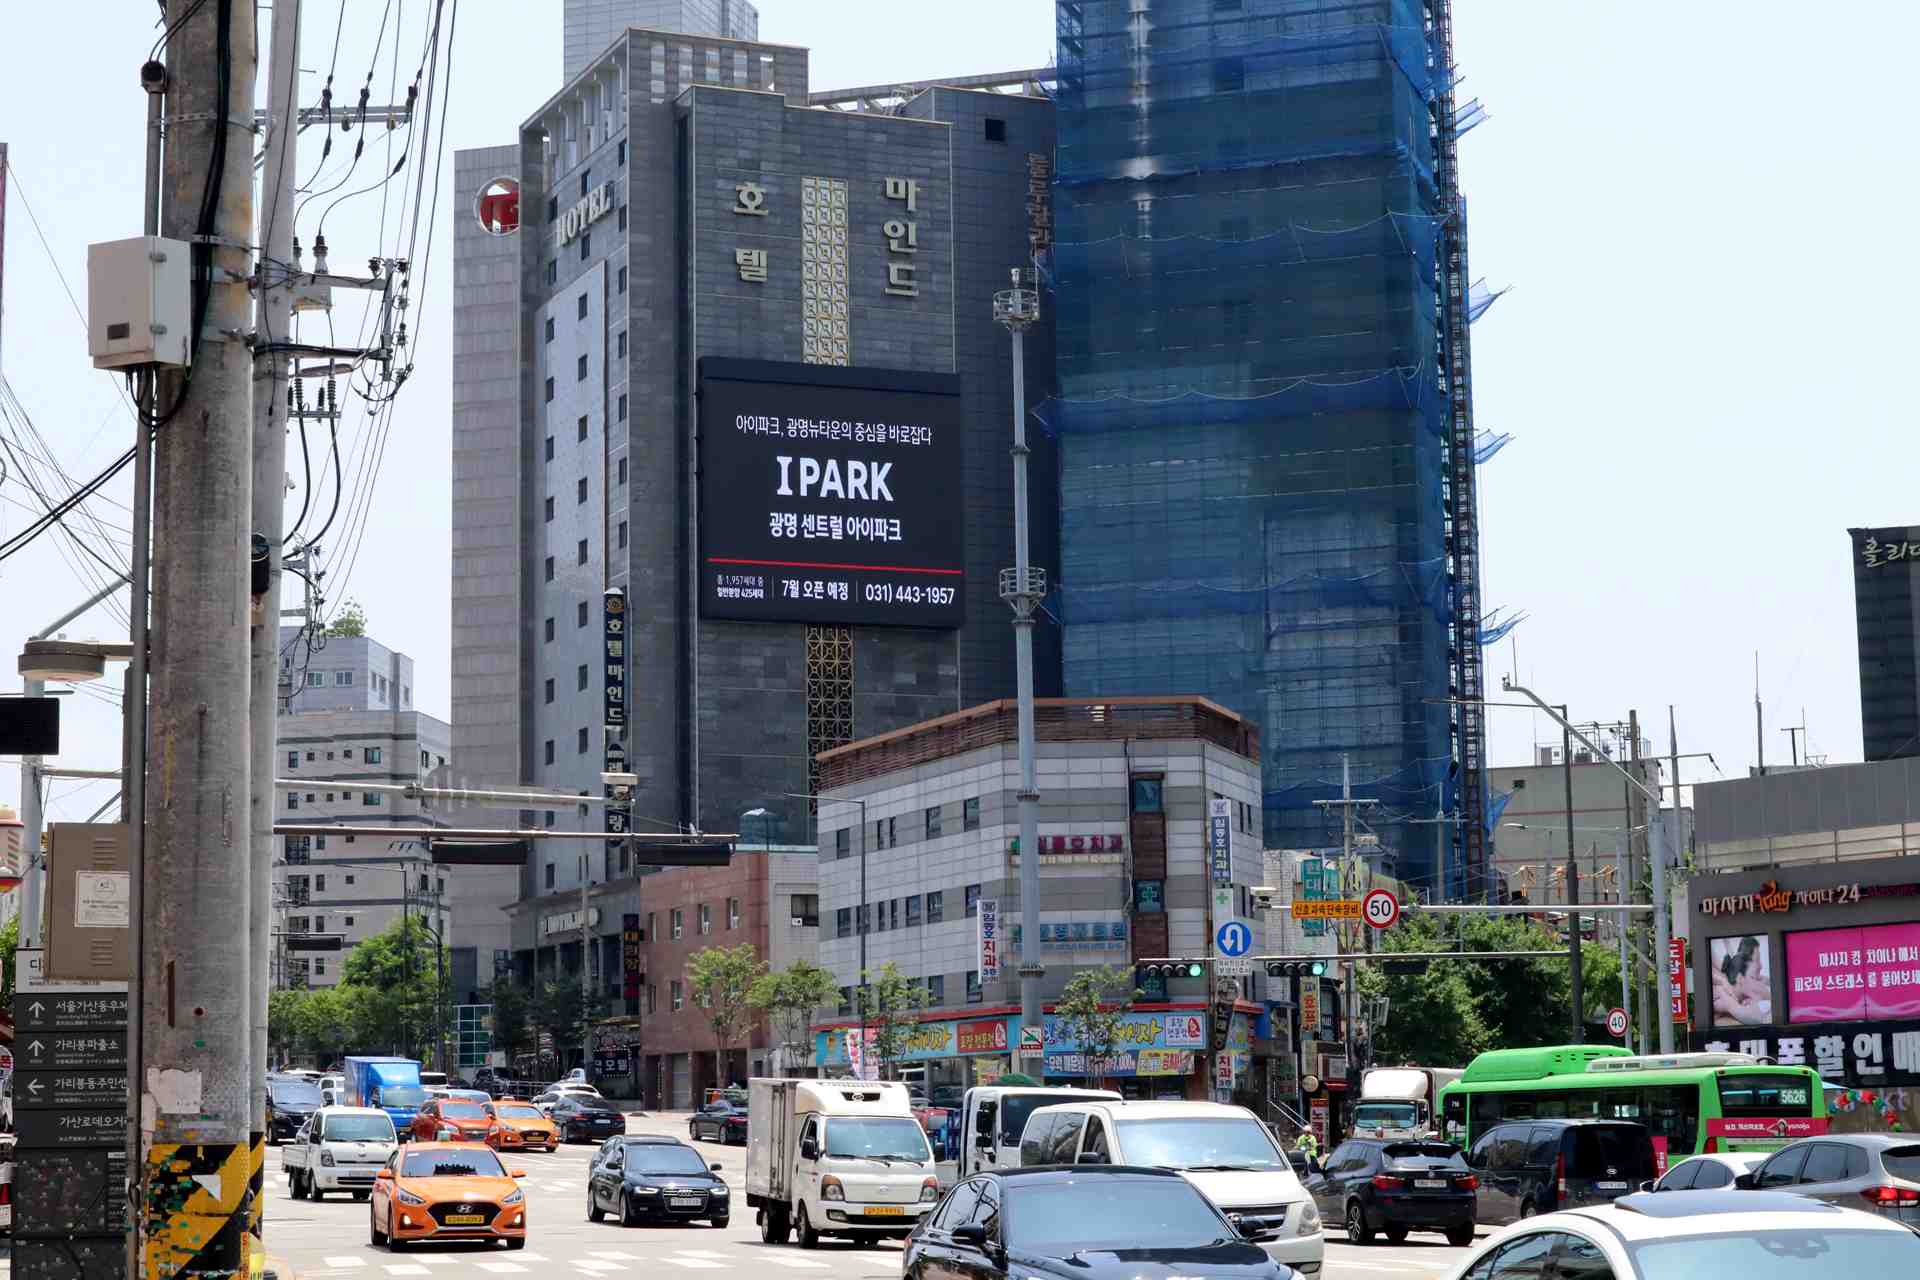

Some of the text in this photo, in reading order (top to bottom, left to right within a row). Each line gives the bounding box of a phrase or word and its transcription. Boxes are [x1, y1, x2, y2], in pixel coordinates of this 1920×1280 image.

[555, 183, 613, 247] HOTEL
[733, 182, 768, 282] 호텔
[883, 176, 919, 297] 마인드
[786, 418, 852, 440] 광명뉴타운의
[854, 423, 887, 443] 중심을
[889, 425, 932, 445] 바로잡다
[769, 512, 902, 541] 광명 센트럴 아이파크
[782, 579, 849, 600] 7월 오픈 예정
[865, 583, 955, 604] 031) 443-1957
[1837, 883, 1860, 904] 24
[1370, 900, 1391, 917] 50
[1611, 1015, 1624, 1029] 40
[1704, 1032, 1920, 1076] 폰할인매
[59, 1115, 127, 1129] 가산로데오거
